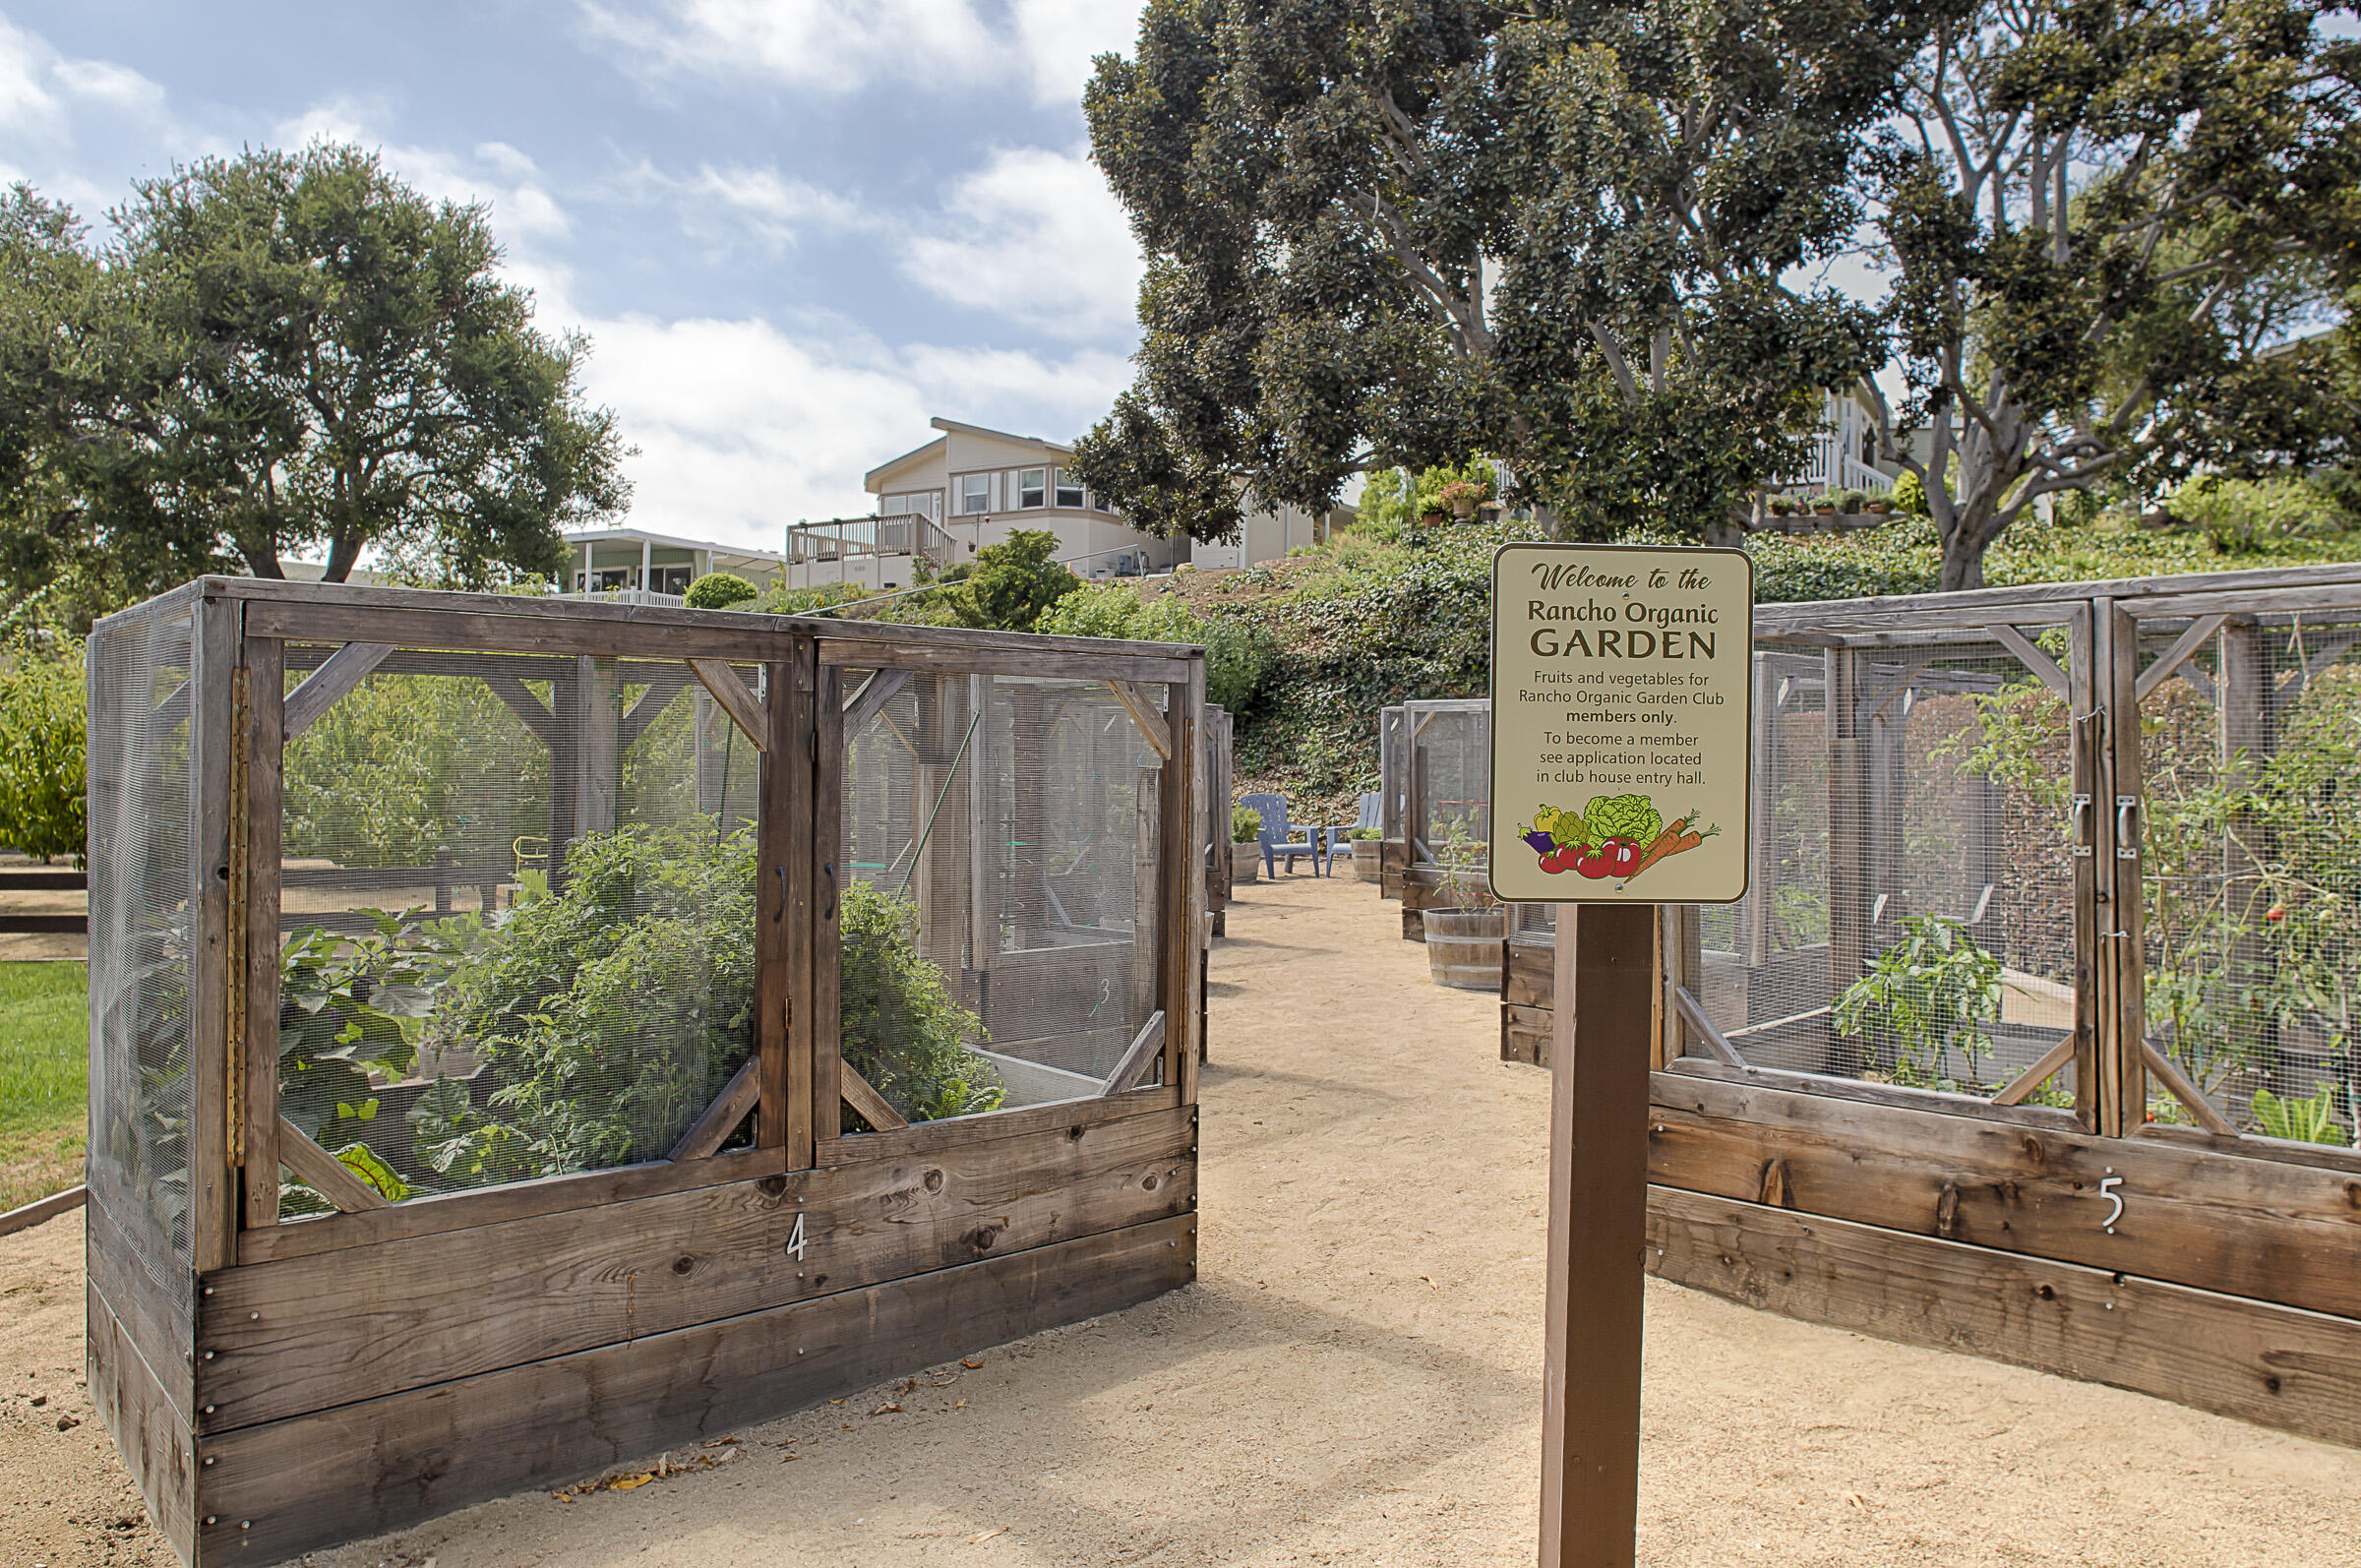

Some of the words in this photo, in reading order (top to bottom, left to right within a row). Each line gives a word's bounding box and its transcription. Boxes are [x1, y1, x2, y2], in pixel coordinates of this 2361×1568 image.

[1532, 563, 1639, 590] Welcome
[1649, 568, 1669, 589] to
[1677, 568, 1712, 590] the
[1528, 598, 1617, 622] Rancho
[1624, 602, 1719, 630] Organic
[1530, 629, 1716, 659] GARDEN
[1534, 670, 1573, 684] Fruits
[1578, 671, 1604, 685] and
[1609, 672, 1684, 689] vegetables
[1688, 672, 1710, 686] for
[1519, 690, 1571, 702] Rancho
[1576, 691, 1632, 707] Organic
[1637, 692, 1688, 704] Garden
[1692, 692, 1725, 705] Club
[1566, 709, 1637, 722] members
[1641, 710, 1677, 726] only.
[1544, 731, 1561, 745] To
[1566, 732, 1622, 745] become
[1626, 736, 1635, 745] a
[1640, 733, 1699, 746] member
[1540, 754, 1562, 763] see
[1567, 751, 1646, 767] application
[1650, 752, 1702, 765] located
[1537, 769, 1549, 782] in
[1553, 769, 1584, 783] club
[1589, 770, 1632, 783] house
[1636, 772, 1672, 787] entry
[1676, 771, 1706, 784] hall.
[2100, 1176, 2123, 1227] 5
[787, 1213, 808, 1262] 4
